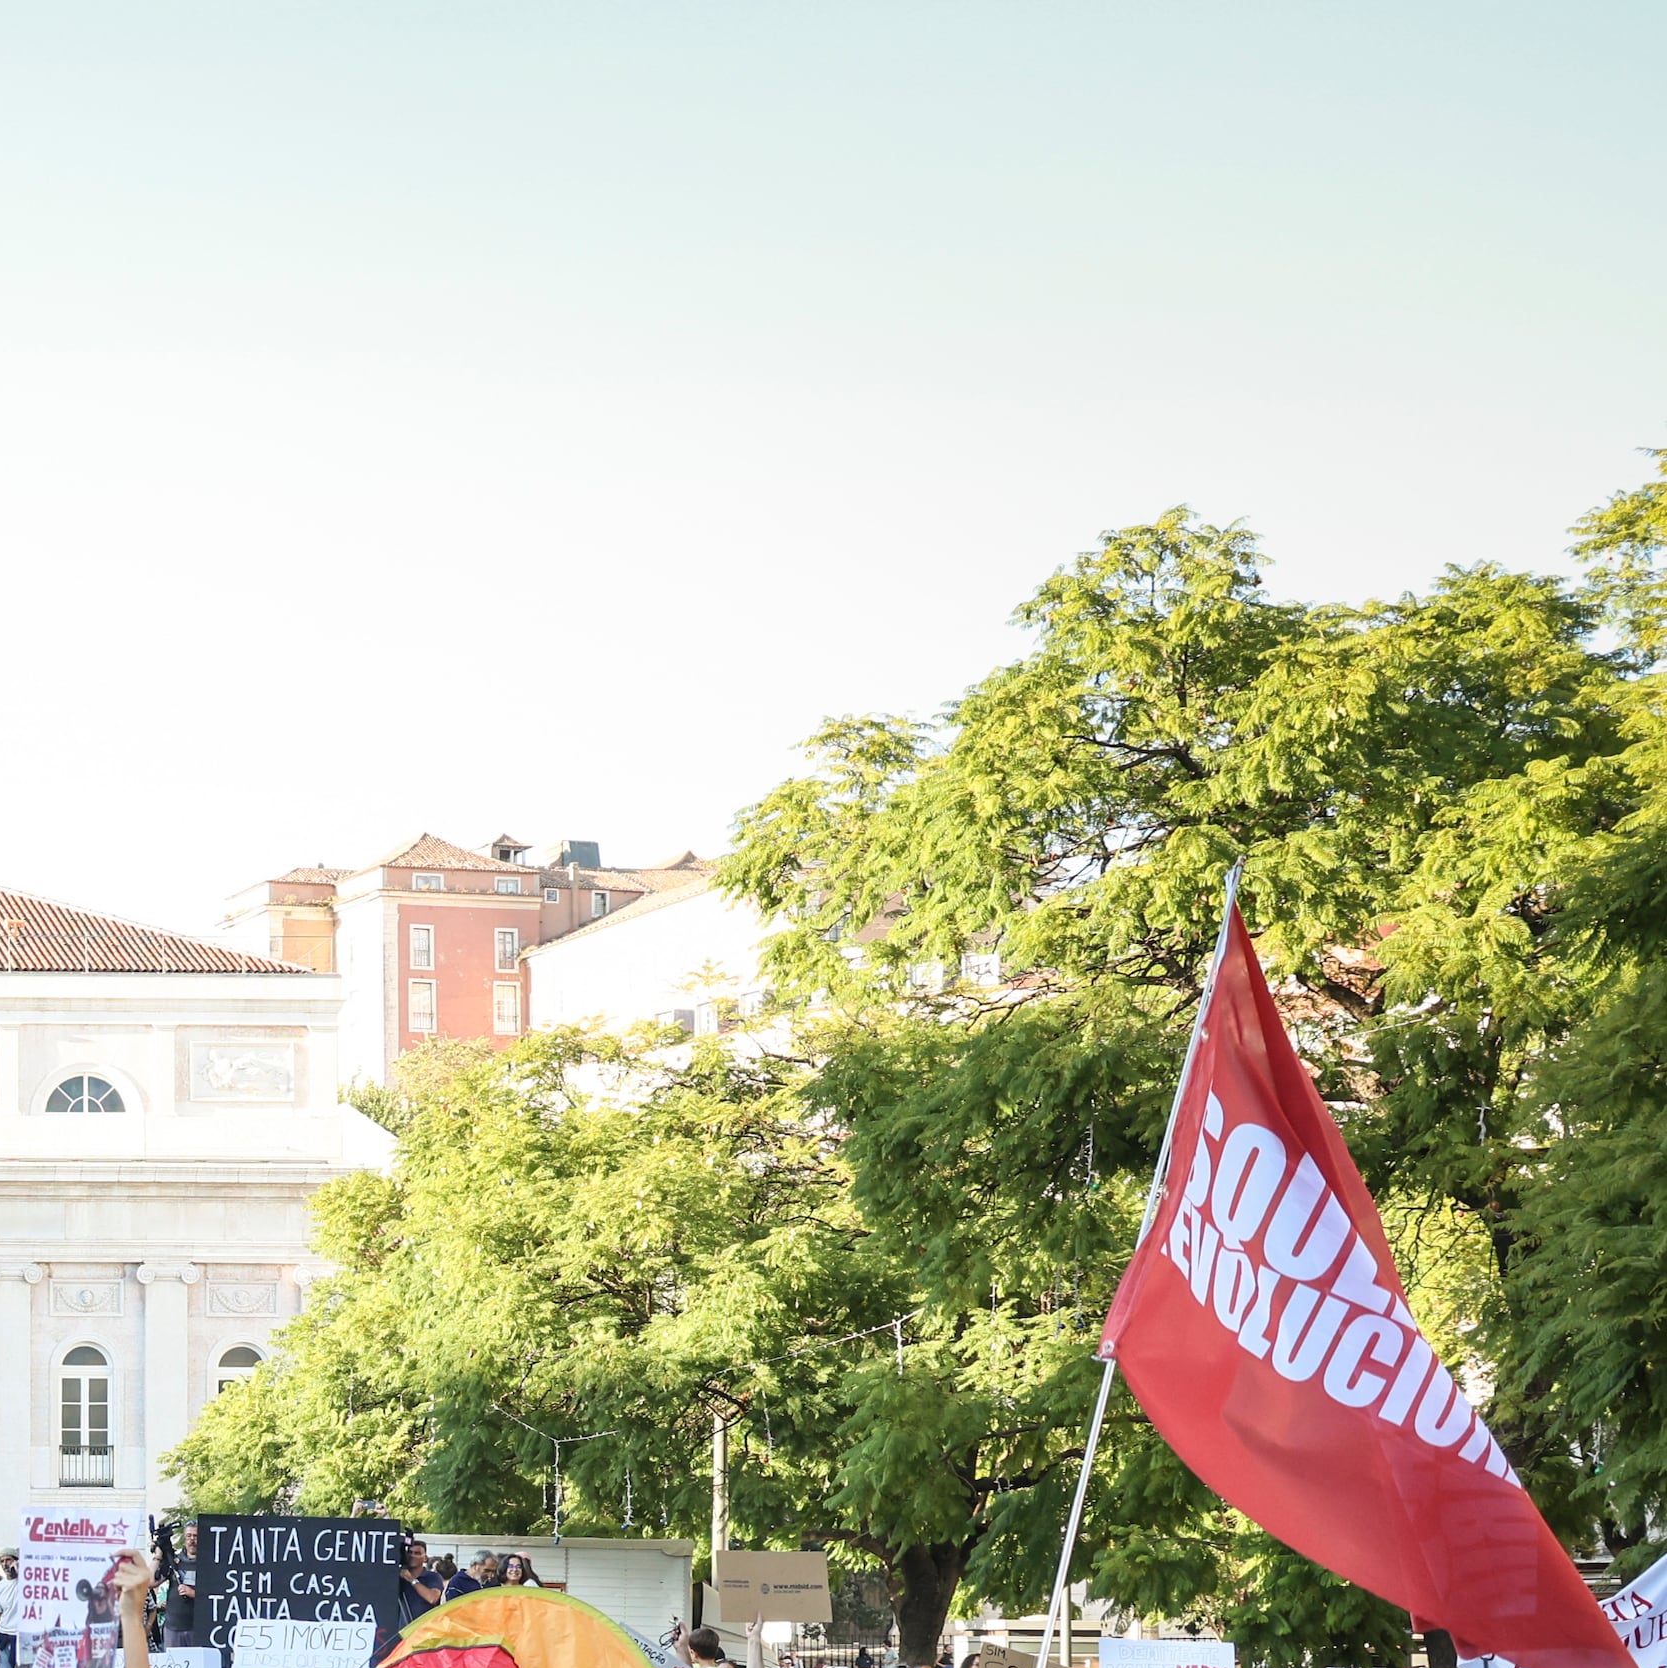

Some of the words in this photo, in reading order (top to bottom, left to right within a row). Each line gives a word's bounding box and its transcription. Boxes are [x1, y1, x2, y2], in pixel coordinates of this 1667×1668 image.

[29, 1517, 108, 1542] Centelha
[210, 1526, 303, 1565] TANTA
[313, 1528, 398, 1565] GENTE
[24, 1567, 70, 1582] GREVE
[225, 1570, 272, 1594] SEM
[290, 1573, 352, 1598] CASA
[23, 1585, 69, 1601] GERAL
[22, 1601, 43, 1620] JÁ!
[208, 1595, 291, 1622] TANTA
[315, 1600, 376, 1623] CASA
[236, 1624, 275, 1650] 55
[283, 1622, 368, 1650] IMÓVEIS
